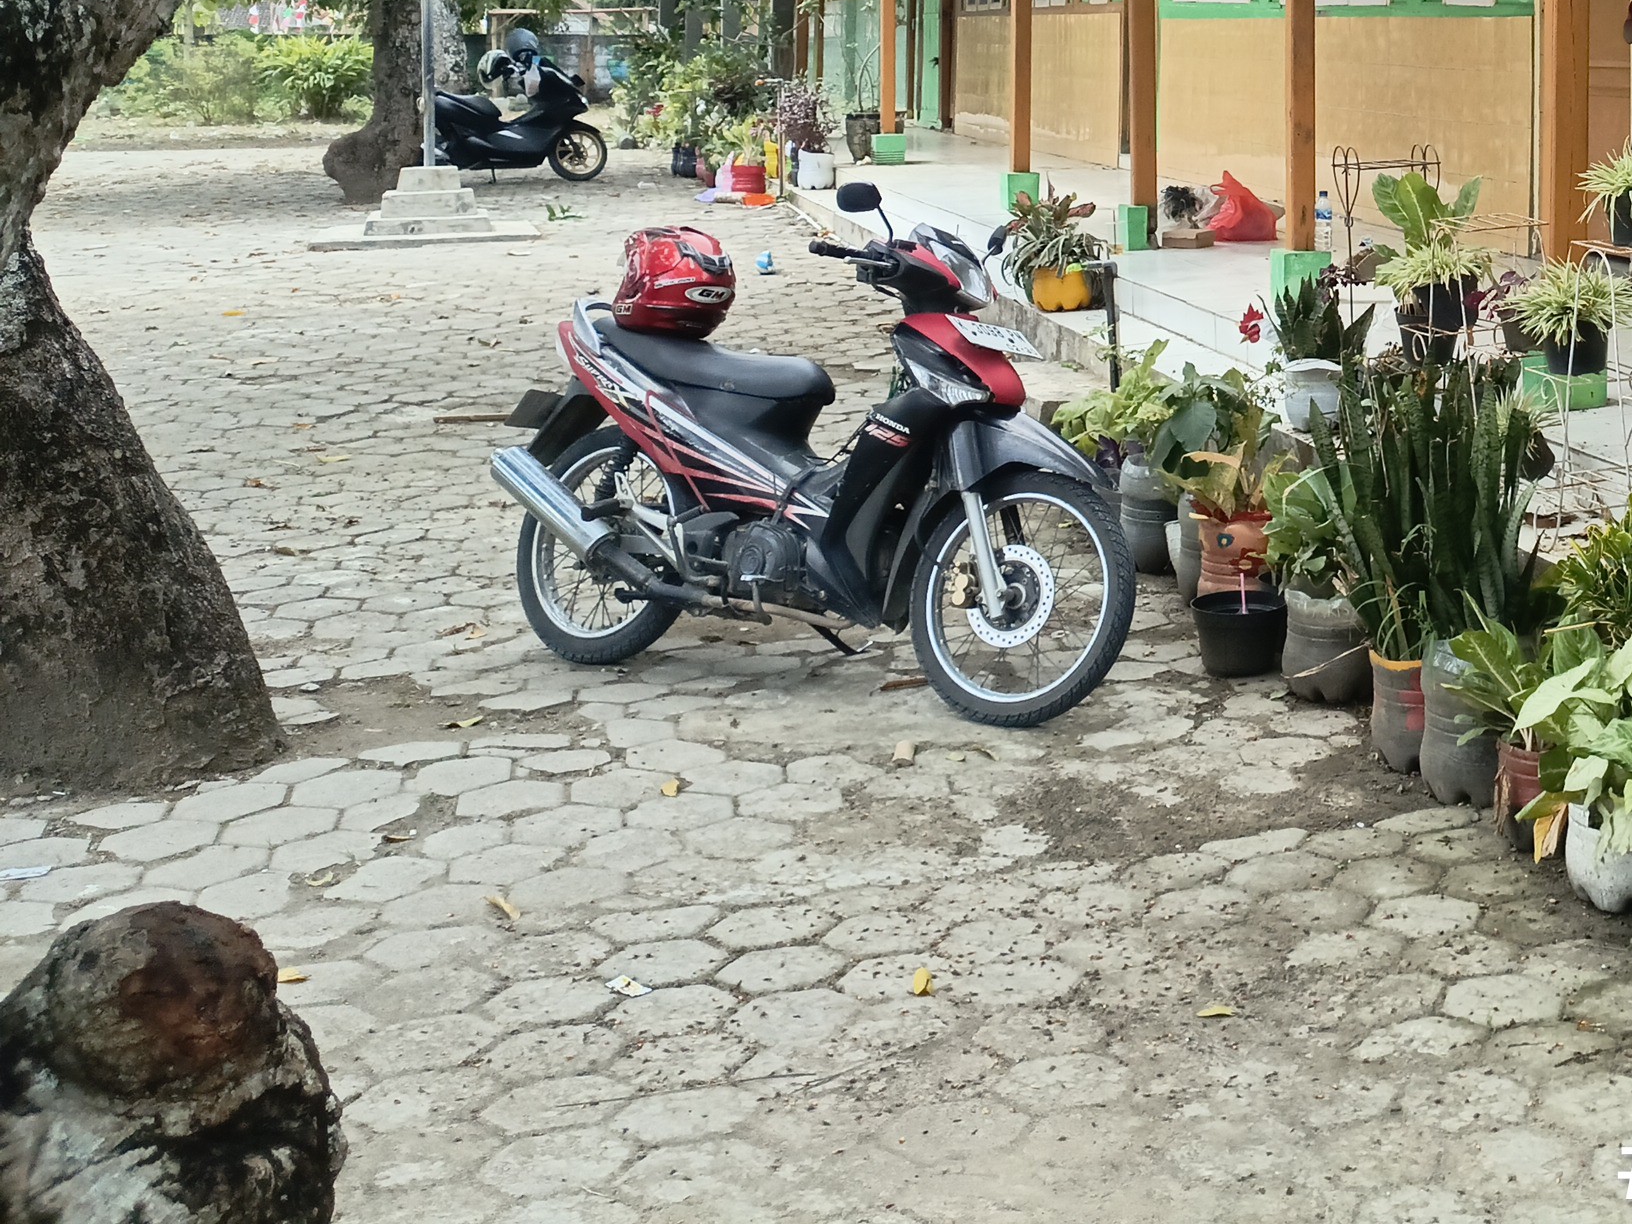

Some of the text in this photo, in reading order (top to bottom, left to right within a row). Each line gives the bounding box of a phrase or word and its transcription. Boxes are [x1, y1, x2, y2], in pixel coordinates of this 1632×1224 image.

[698, 288, 726, 300] GM
[616, 304, 632, 314] GM
[875, 413, 910, 434] HONDA
[864, 423, 912, 447] 125
